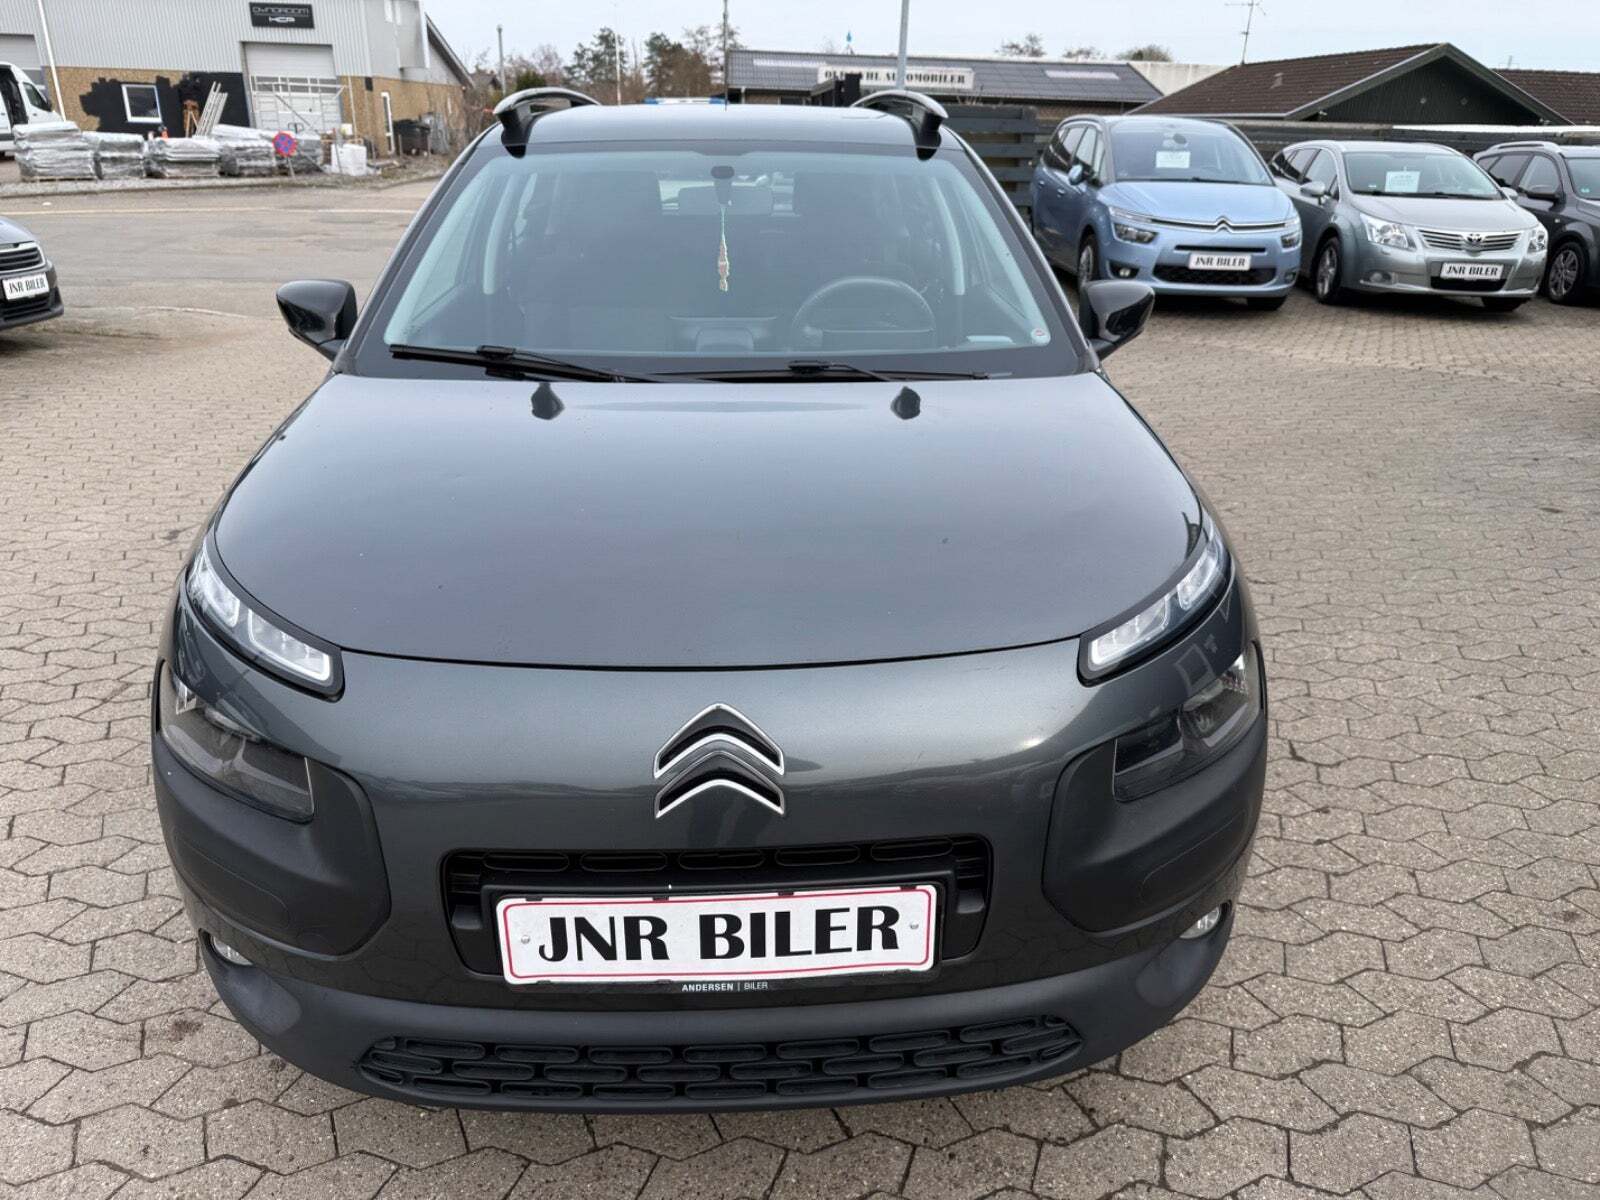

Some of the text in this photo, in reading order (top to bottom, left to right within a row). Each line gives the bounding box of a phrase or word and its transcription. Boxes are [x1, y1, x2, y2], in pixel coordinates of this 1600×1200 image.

[884, 71, 965, 84] AUOMOBILER
[1216, 257, 1246, 267] BILER
[1447, 265, 1499, 276] JNR BILER
[538, 905, 901, 963] JNR BILER
[681, 981, 769, 992] ANDERSEN BILER
